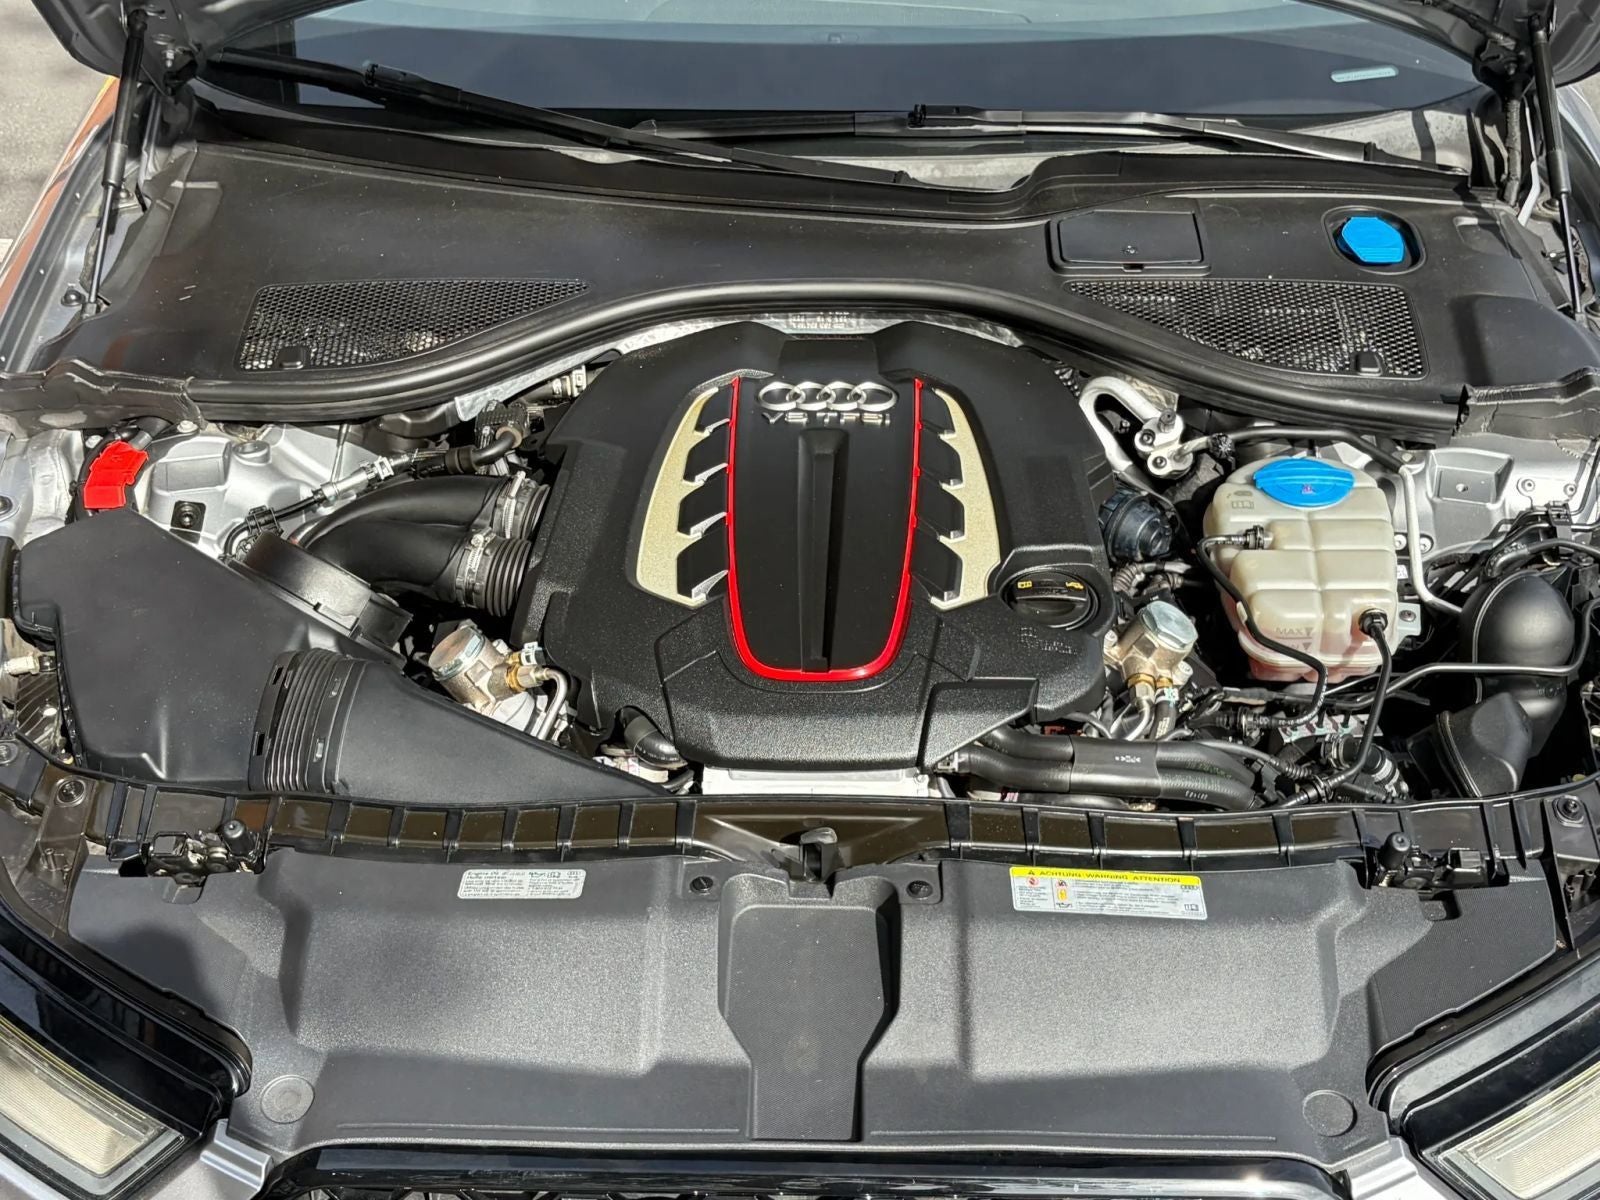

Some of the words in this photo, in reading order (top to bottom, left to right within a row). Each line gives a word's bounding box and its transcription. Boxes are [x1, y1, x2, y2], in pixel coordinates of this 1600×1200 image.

[762, 412, 808, 425] V8
[816, 412, 890, 425] TFSI
[1039, 870, 1081, 878] ACHTUNG
[1133, 875, 1181, 883] ATTENTION
